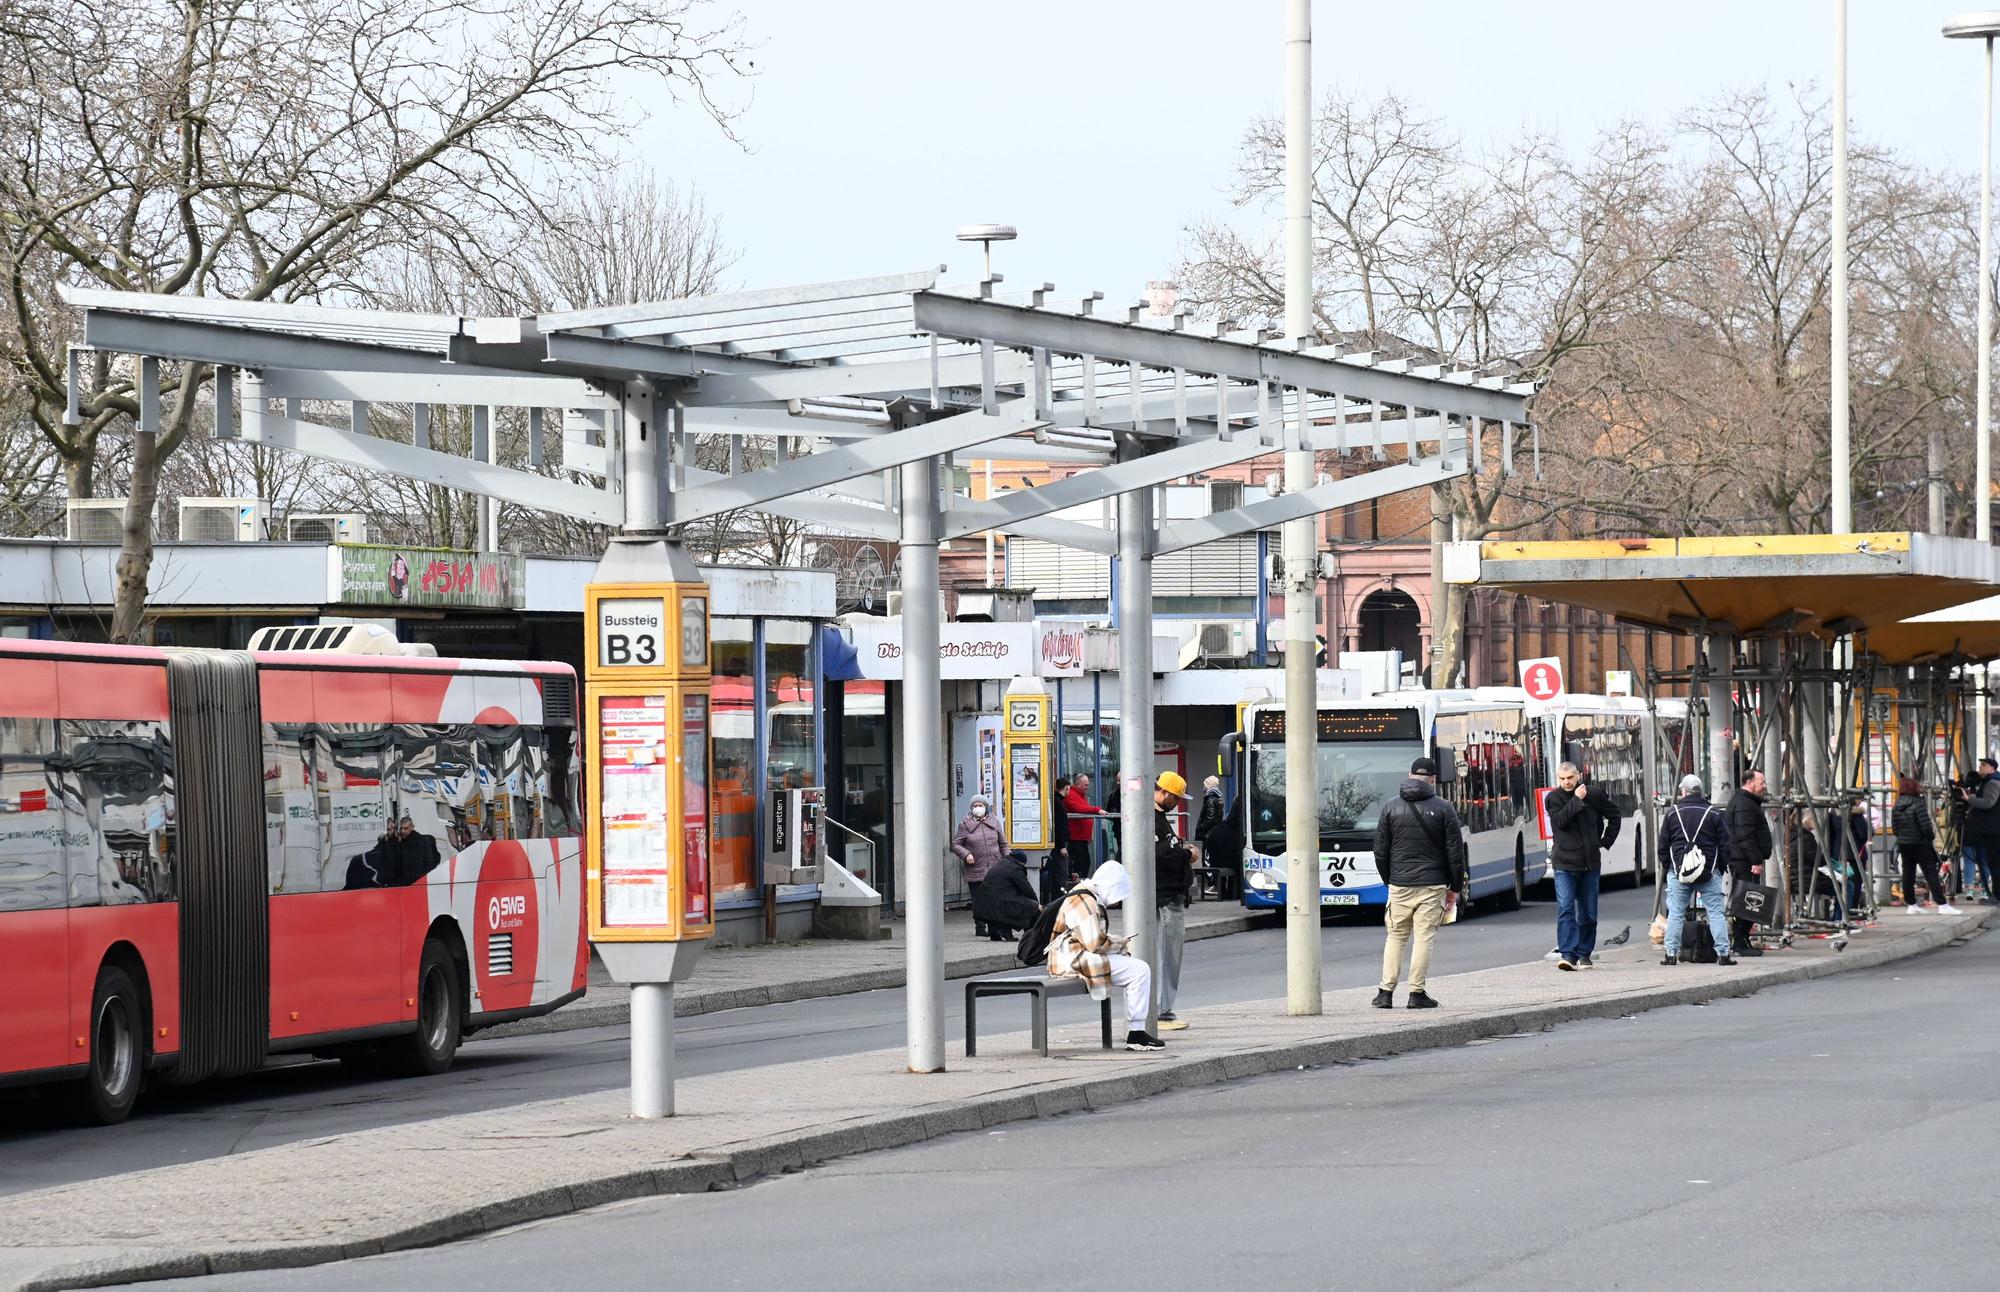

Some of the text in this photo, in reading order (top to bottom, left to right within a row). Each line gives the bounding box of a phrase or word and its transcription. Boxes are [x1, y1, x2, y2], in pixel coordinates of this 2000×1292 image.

[421, 559, 474, 594] ASIA
[604, 614, 658, 628] Bussteig
[608, 634, 656, 664] B3
[683, 626, 701, 657] B3
[878, 643, 900, 659] Die
[961, 641, 1009, 660] Schärfe
[1013, 713, 1037, 728] C2
[776, 799, 784, 845] zigaretten
[501, 896, 525, 915] SWB
[1342, 895, 1356, 903] 256
